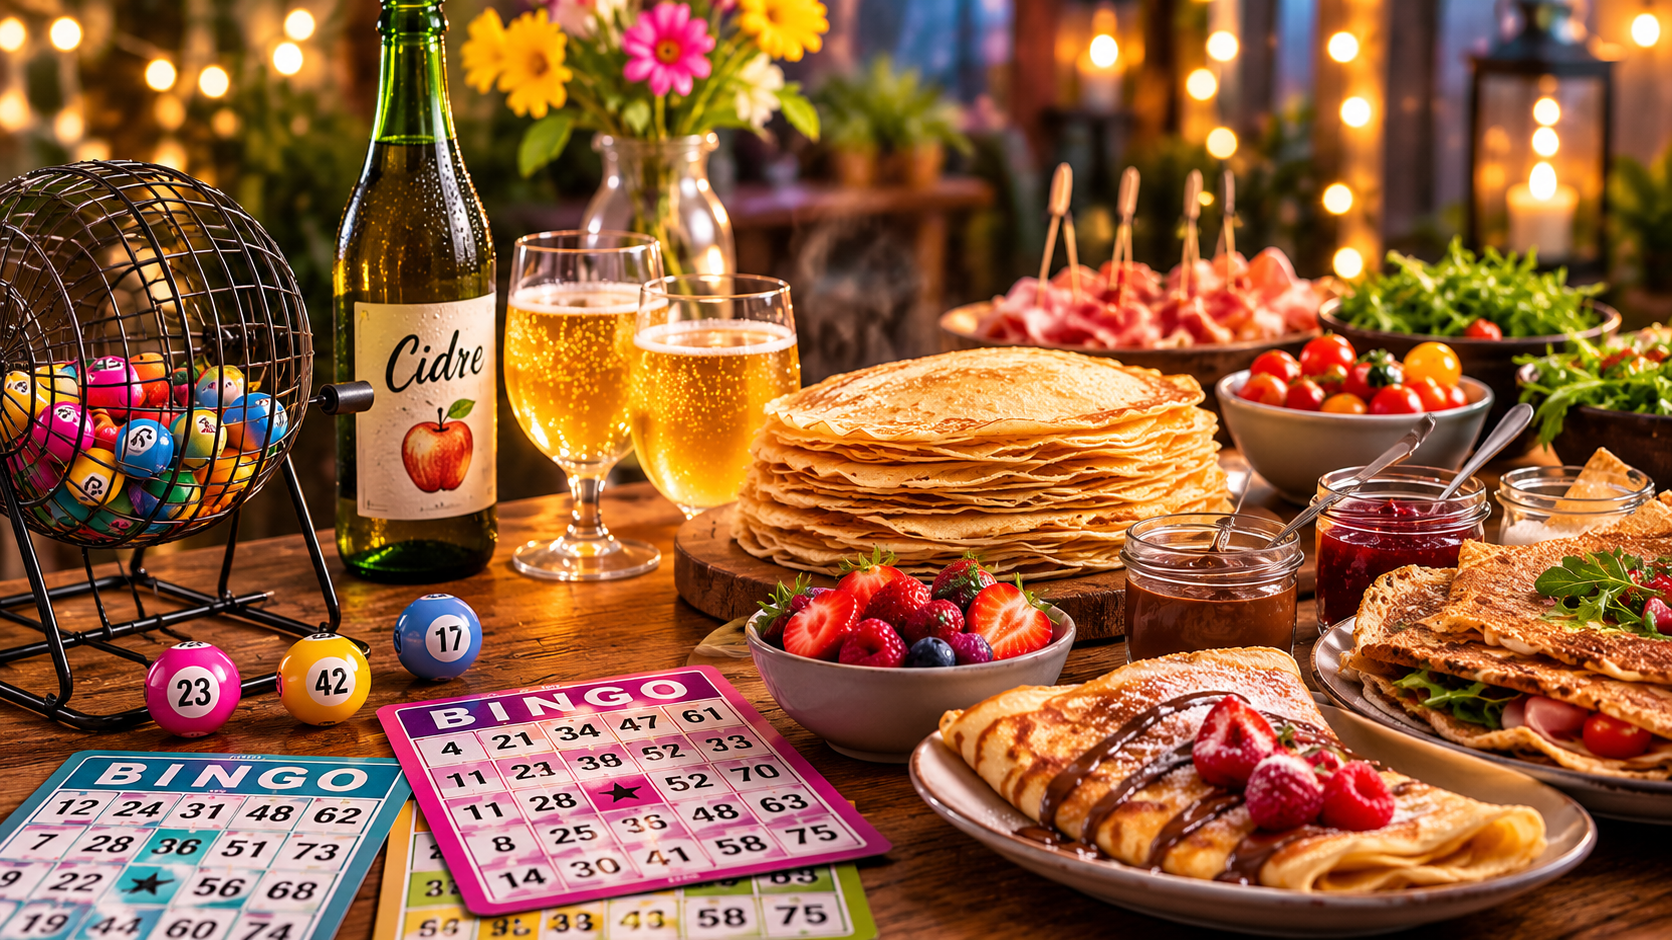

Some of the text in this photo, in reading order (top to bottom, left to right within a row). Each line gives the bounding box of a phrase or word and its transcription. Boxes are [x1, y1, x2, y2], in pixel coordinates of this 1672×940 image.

[386, 329, 484, 393] Cidre
[436, 626, 461, 652] 17
[177, 677, 212, 707] 23
[315, 668, 347, 696] 42
[429, 679, 689, 730] BINGO
[442, 707, 723, 755] 4 21 34 47 61
[447, 770, 487, 788] 11
[641, 743, 686, 761] 52
[706, 735, 753, 751] 33
[94, 762, 368, 792] BINGO
[464, 764, 780, 820] 11 28 52 70
[57, 799, 361, 824] 12 24 31 48 62
[492, 794, 808, 852] 8 25 36 48 63
[31, 834, 339, 860] 7 28 36 51 73
[500, 825, 837, 888] 14 30 41 58 75
[50, 873, 102, 891] 22
[194, 878, 245, 897] 56
[267, 882, 317, 899] 68
[21, 914, 293, 940] 19 44 60 74
[699, 908, 745, 926] 58
[777, 906, 827, 924] 75
